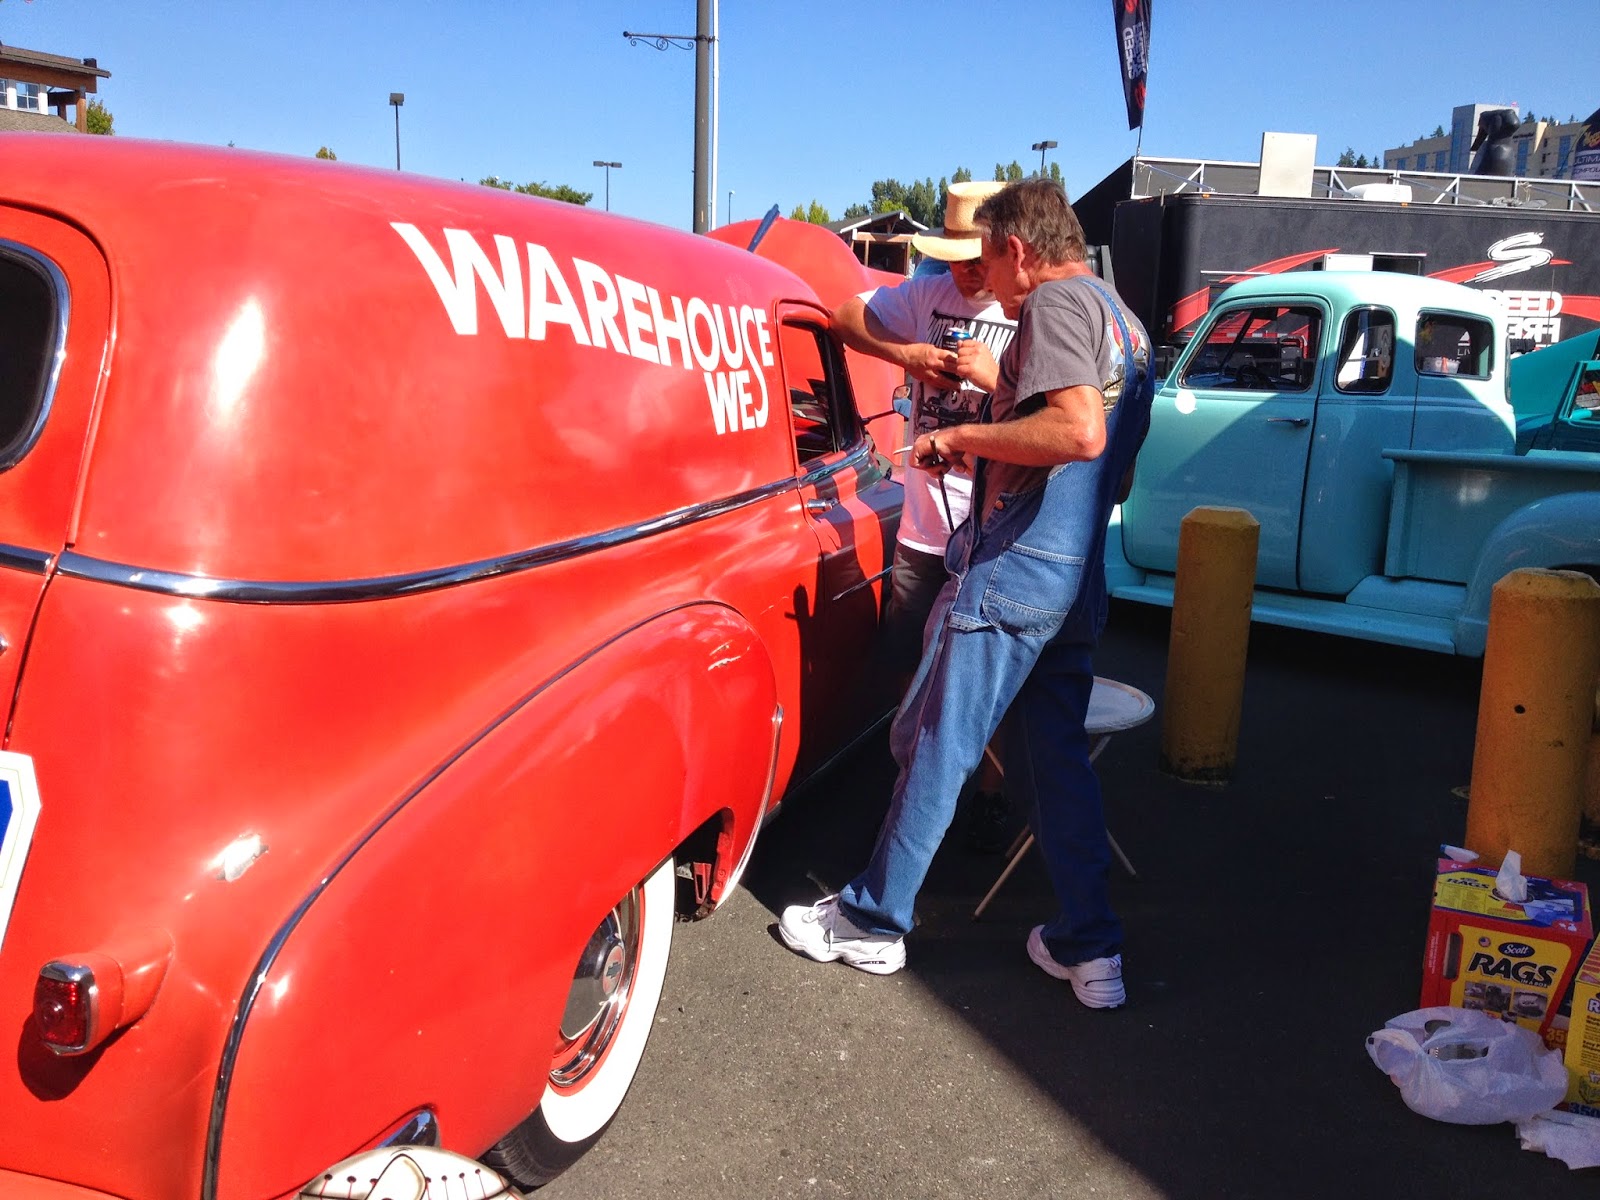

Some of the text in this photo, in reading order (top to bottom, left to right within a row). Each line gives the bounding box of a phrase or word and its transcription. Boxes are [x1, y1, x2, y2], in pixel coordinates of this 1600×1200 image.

[389, 221, 774, 371] WAREHOUSE
[1474, 289, 1563, 318] PEED
[1504, 944, 1529, 955] Scott
[1468, 952, 1557, 986] RAGS
